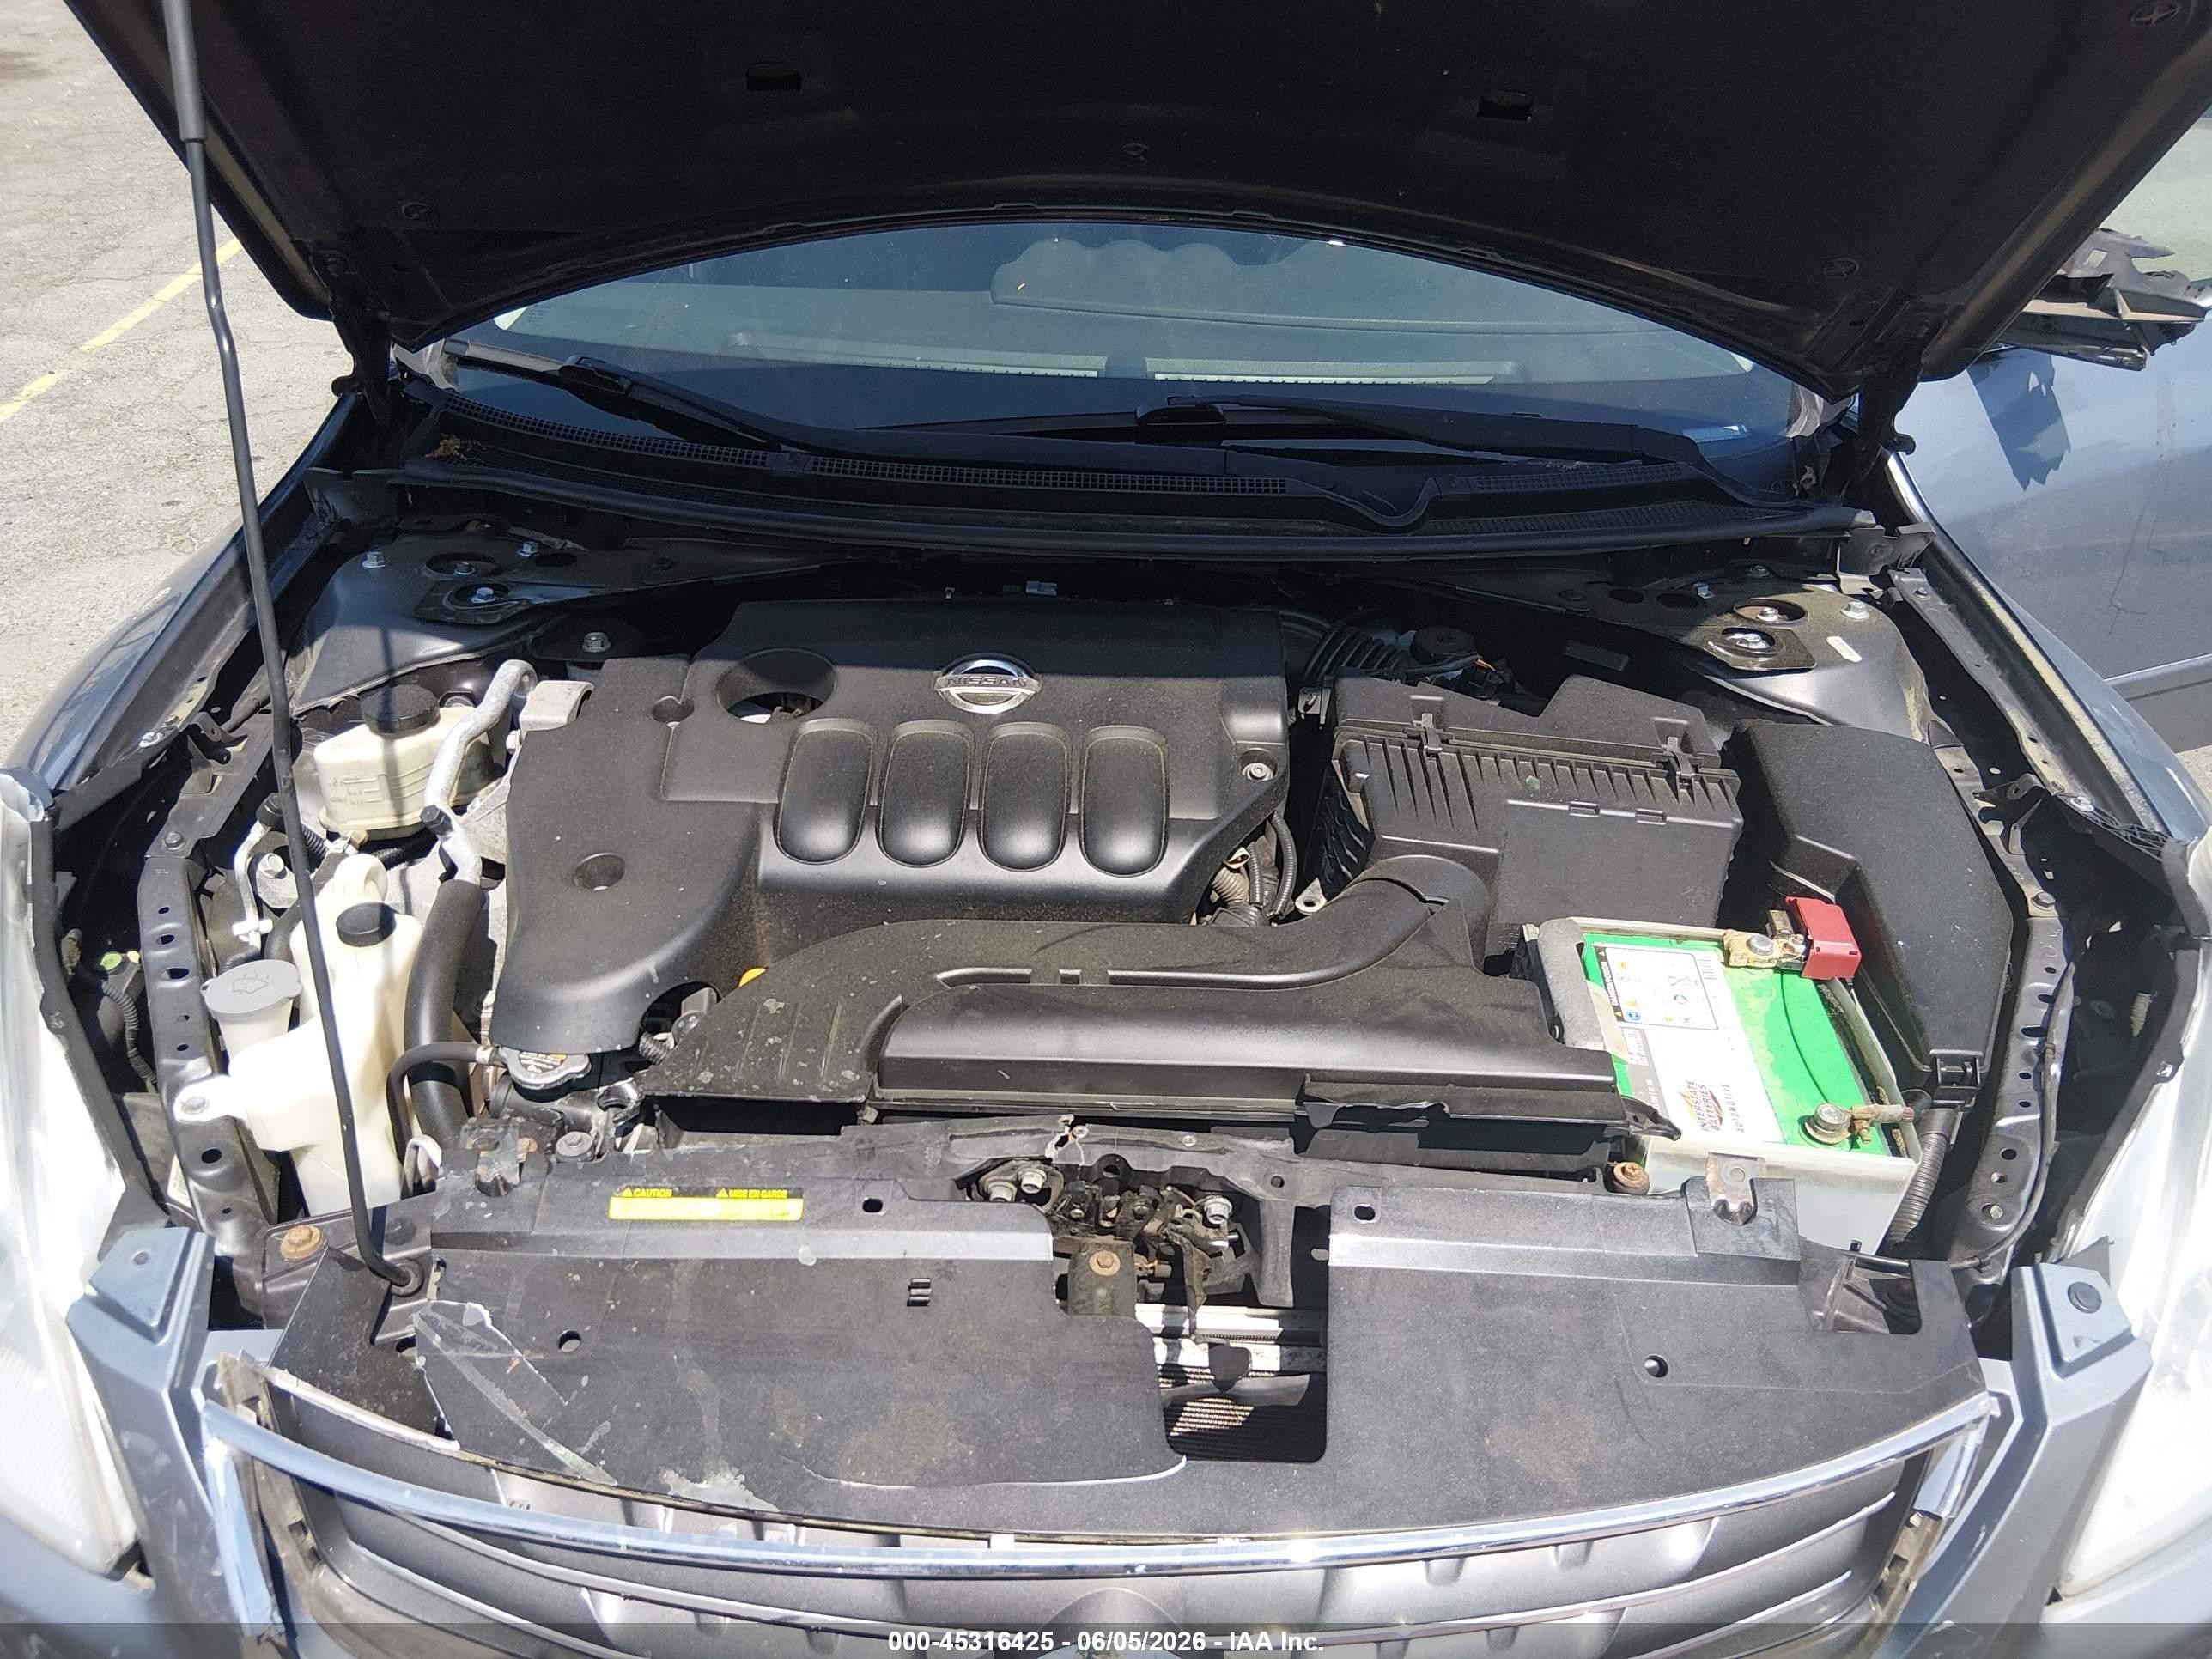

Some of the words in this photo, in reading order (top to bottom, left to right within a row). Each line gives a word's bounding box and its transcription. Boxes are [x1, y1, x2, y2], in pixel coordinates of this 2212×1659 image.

[947, 675, 1028, 687] NISSAN
[1686, 1079, 1710, 1132] INTERSTATE
[1698, 1084, 1720, 1131] BATTERIES
[1721, 1084, 1745, 1133] AUTOMOTIVE
[633, 1188, 673, 1198] CAUTION
[761, 1189, 788, 1199] GARDE
